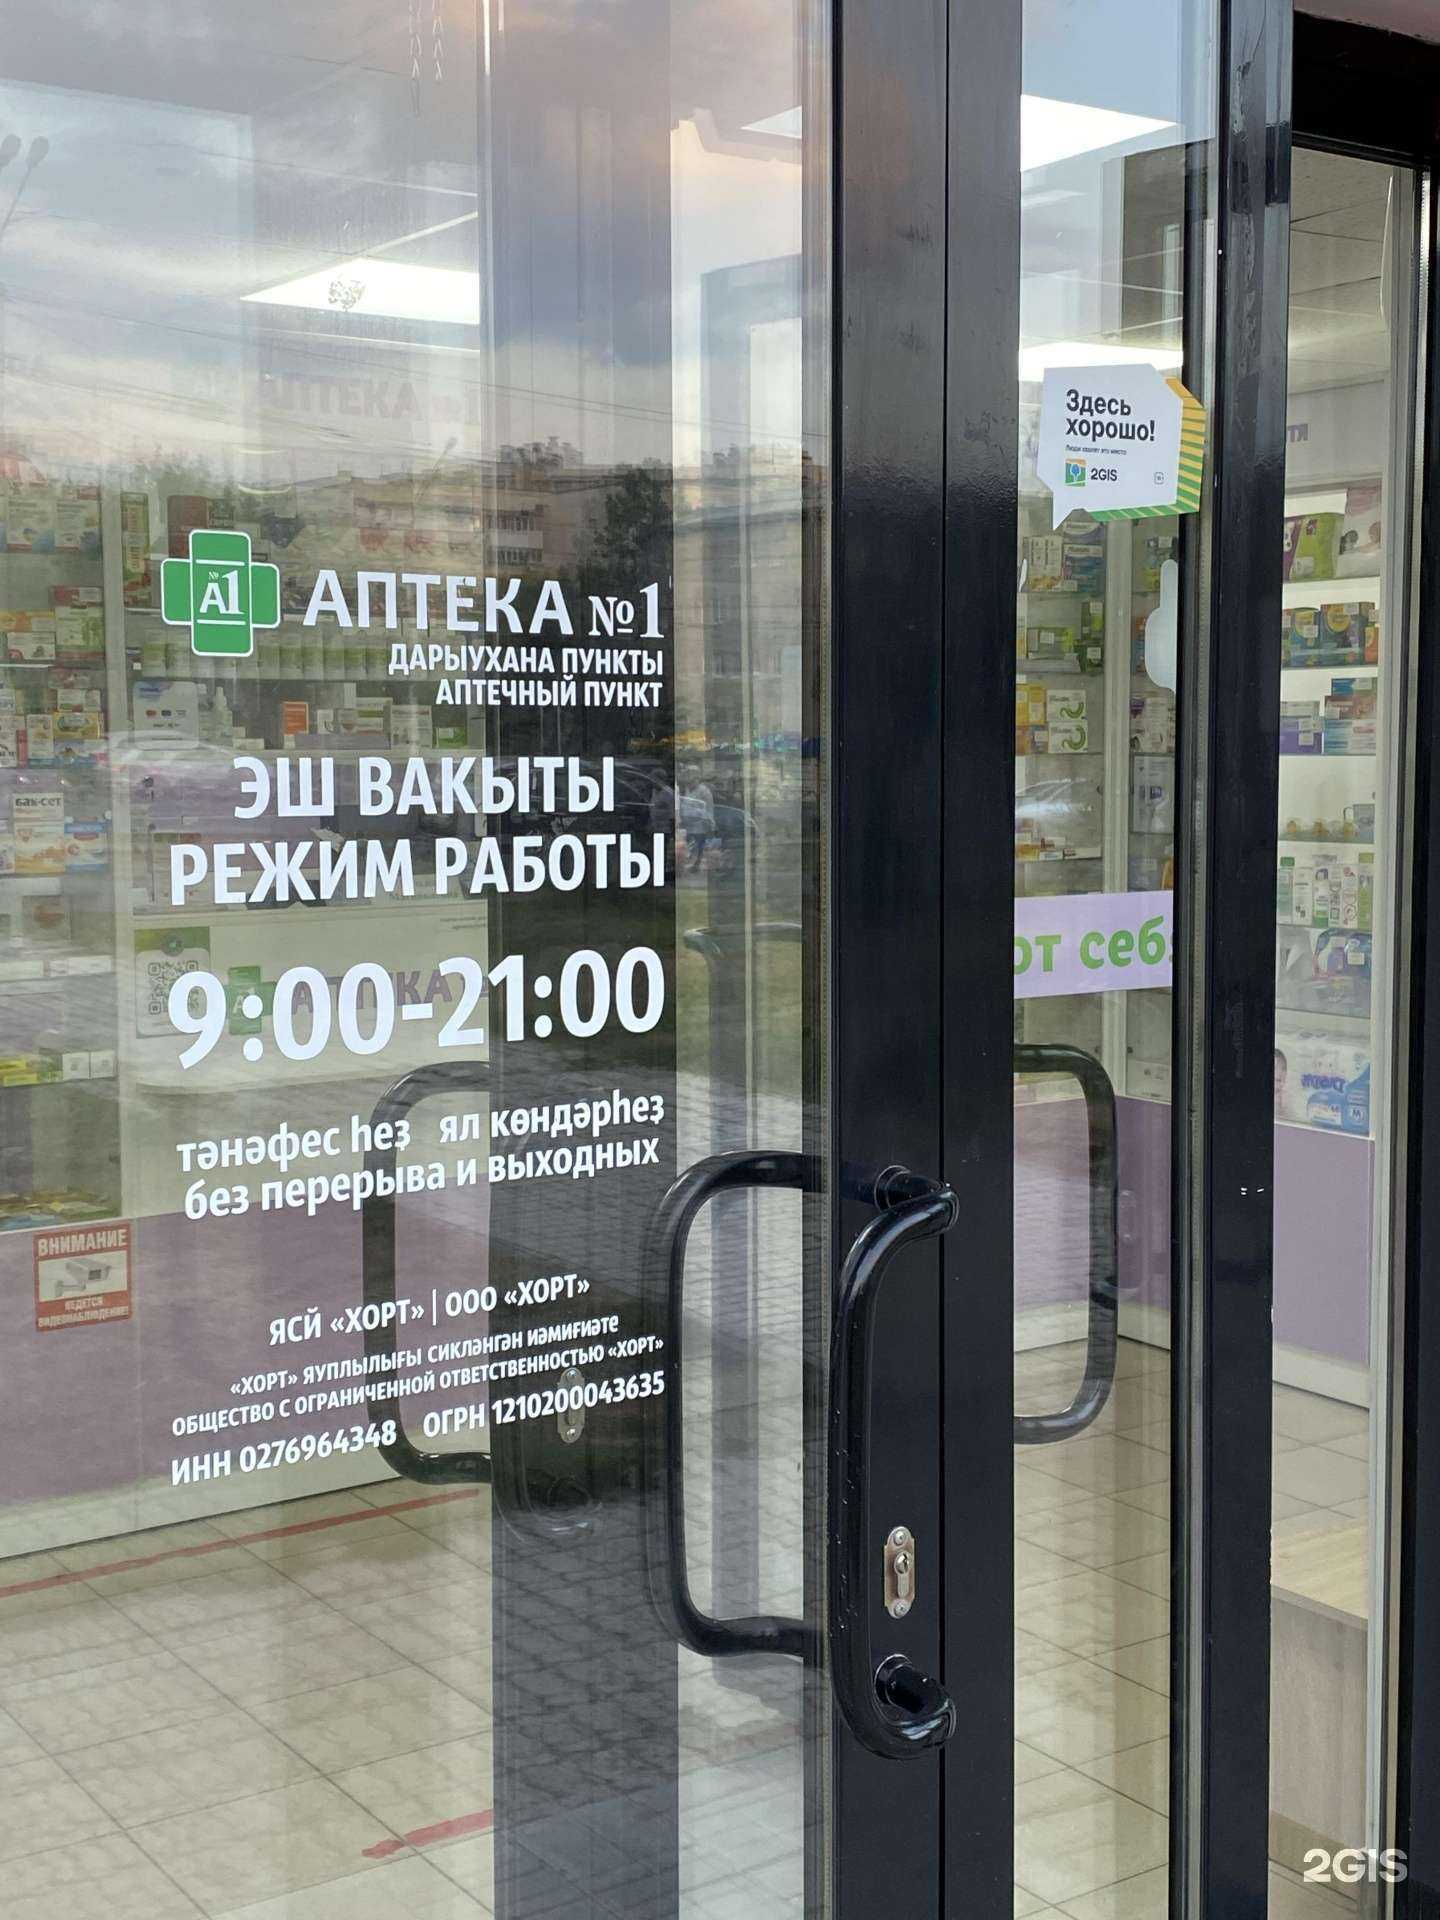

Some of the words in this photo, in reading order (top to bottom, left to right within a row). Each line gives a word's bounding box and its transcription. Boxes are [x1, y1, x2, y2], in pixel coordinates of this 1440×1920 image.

[1065, 418, 1155, 442] хорошо!
[1066, 388, 1131, 416] Здесь
[1090, 467, 1118, 481] 2GIS
[303, 569, 573, 635] АПТЕКА
[588, 582, 664, 638] №1
[388, 643, 554, 676] ДАРЫУХАНА
[562, 648, 663, 676] ПУНКТЫ
[436, 675, 576, 706] АПТЕЧНЫЙ
[584, 681, 662, 707] ПУНКТ
[233, 756, 334, 818] ЭШ
[359, 756, 614, 816] ВАКЫТЫ
[170, 838, 414, 906] РЕЖИМ
[435, 833, 664, 895] РАБОТЫ
[1079, 915, 1173, 970] себ
[168, 946, 665, 1070] 9:00-21:00
[176, 1122, 340, 1173] тәнәфес
[439, 1113, 479, 1143] ял
[185, 1179, 249, 1220] без
[262, 1162, 445, 1217] перерыва
[457, 1158, 477, 1186] и
[489, 1138, 660, 1183] выходных
[38, 1229, 127, 1257] ВНИМАНИЕ
[269, 1303, 322, 1346] ЯСЙ
[330, 1296, 424, 1337] «ХОРТ»
[445, 1286, 497, 1318] ООО
[504, 1274, 590, 1306] «ХОРТ»
[172, 1402, 274, 1437] ОБЩЕСТВО
[279, 1400, 291, 1418] С
[295, 1370, 435, 1415] ОГРАНИЧЕННОЙ
[440, 1345, 605, 1389] ОТВЕТСТВЕННОСТЬЮ
[608, 1335, 664, 1358] «ХОРТ»
[230, 1370, 298, 1395] «ХОРТ»
[171, 1450, 231, 1486] ИНН
[239, 1420, 397, 1474] 0276964348
[423, 1403, 485, 1438] ОГРН
[492, 1371, 665, 1425] 1210200043635
